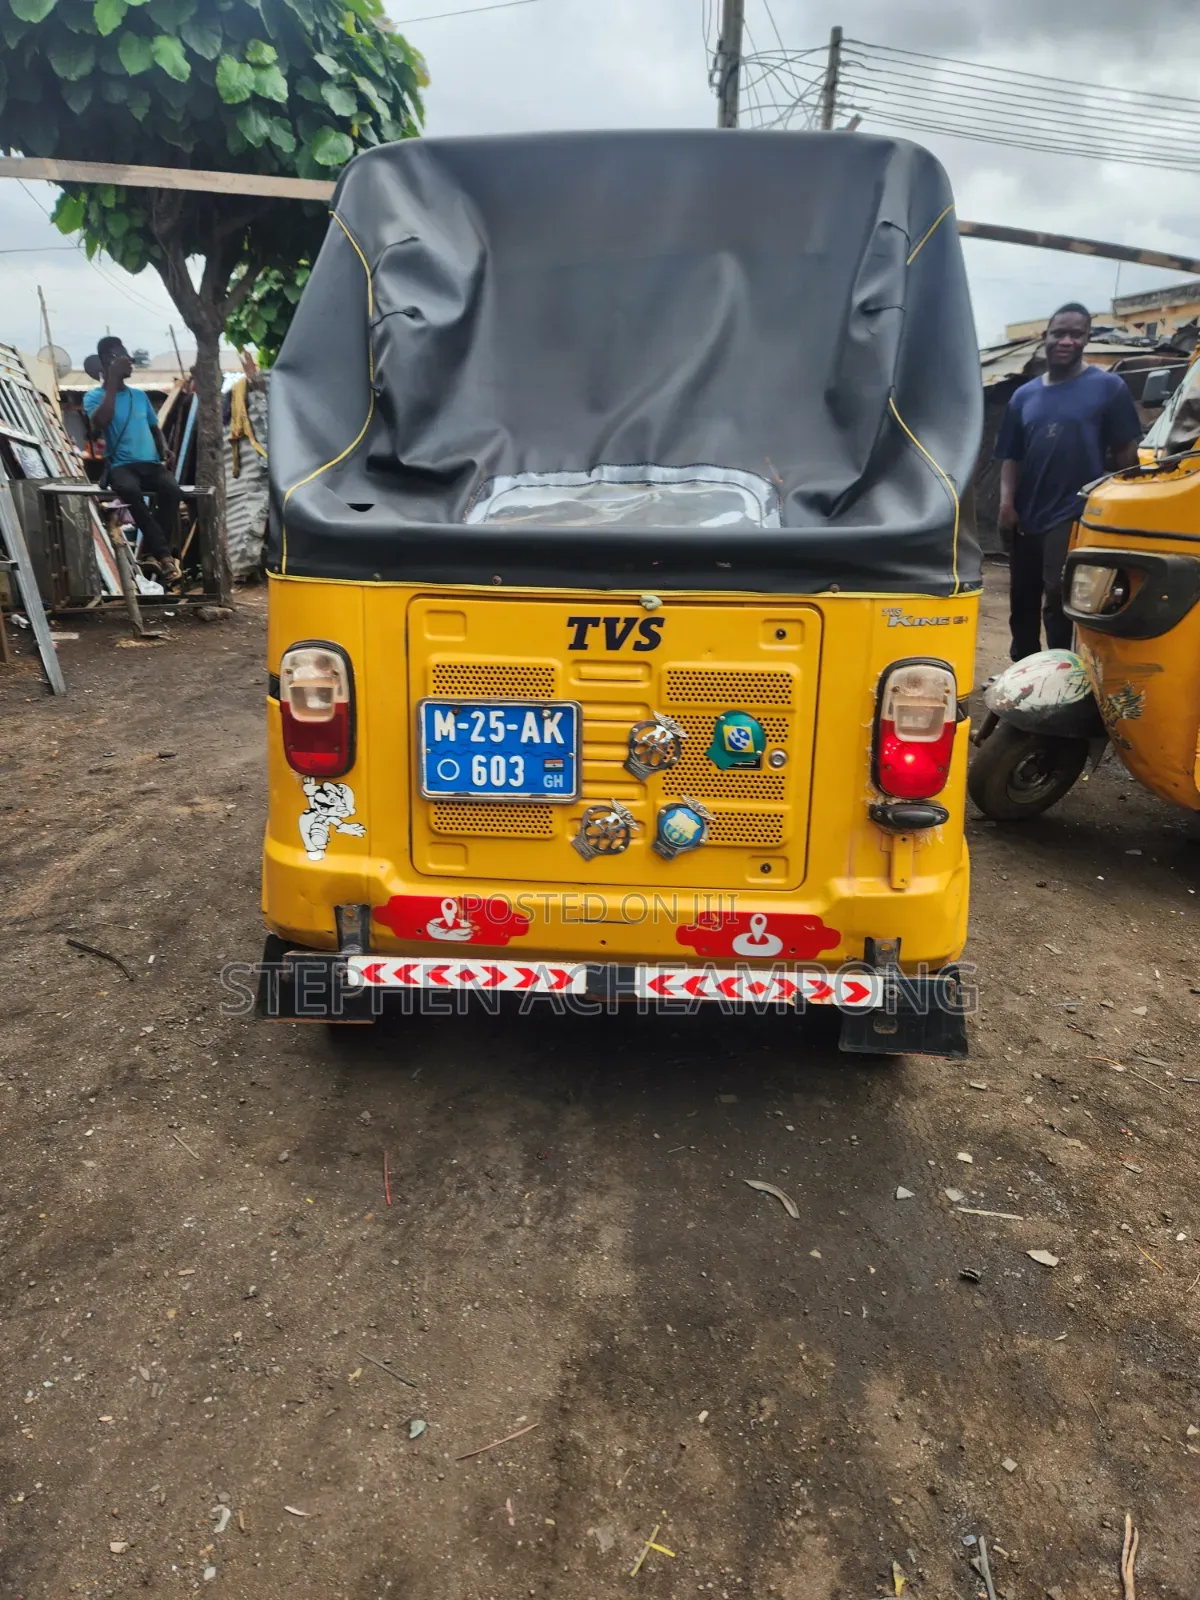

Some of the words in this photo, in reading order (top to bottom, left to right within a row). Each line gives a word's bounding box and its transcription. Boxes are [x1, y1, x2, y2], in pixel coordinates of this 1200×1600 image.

[566, 616, 666, 652] TVS
[434, 709, 565, 744] M-25-AK
[471, 754, 525, 787] 603
[543, 774, 563, 788] GH
